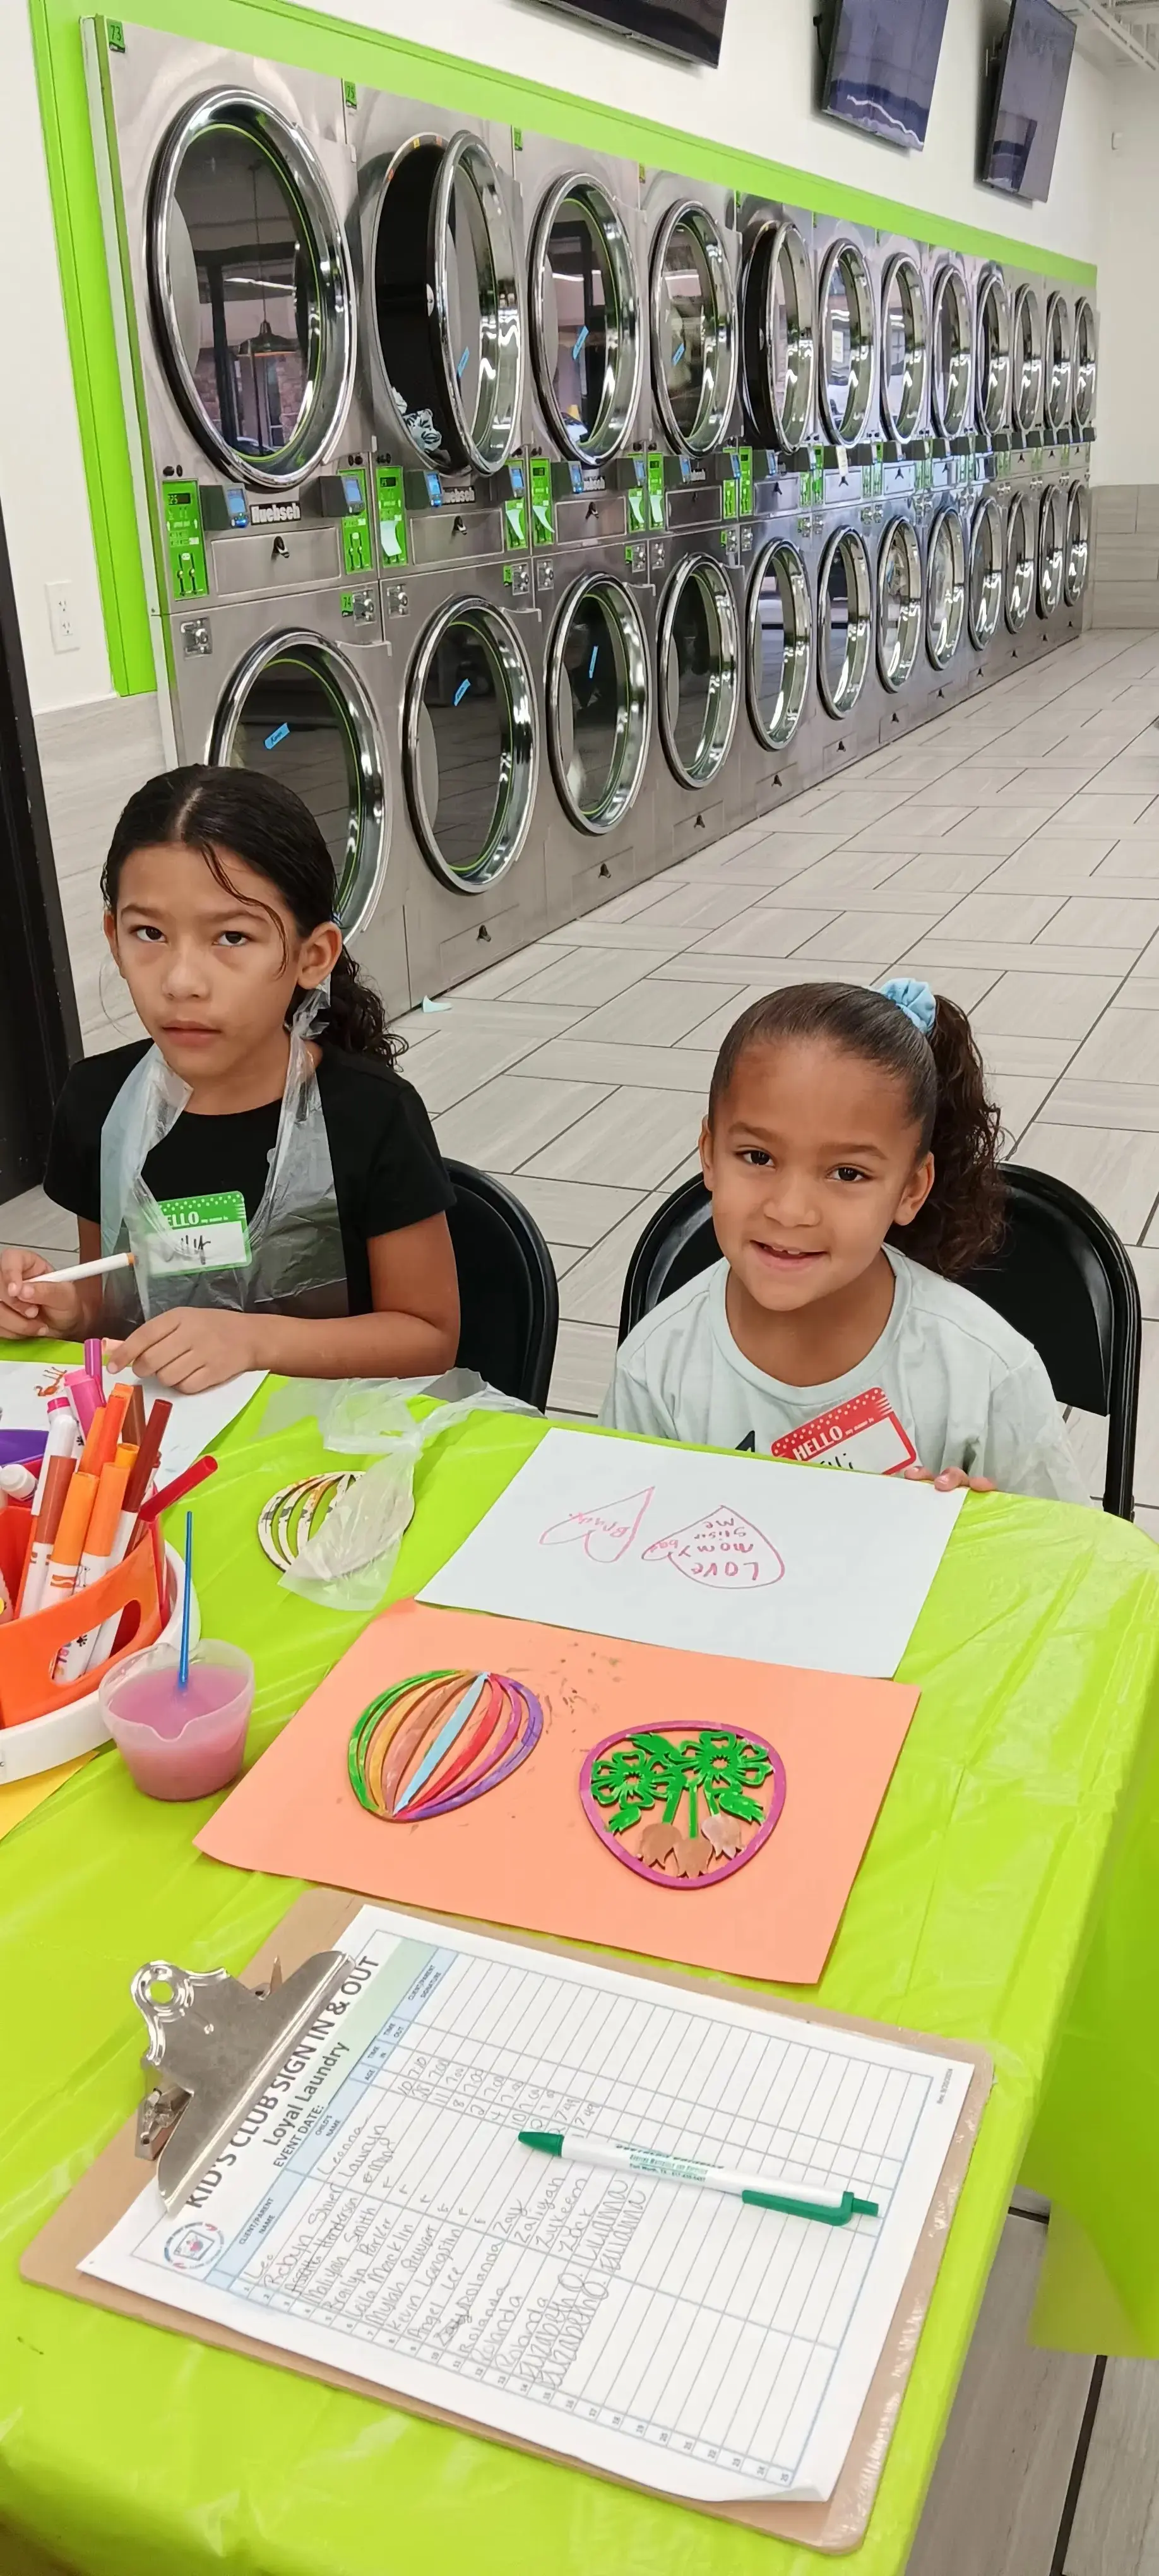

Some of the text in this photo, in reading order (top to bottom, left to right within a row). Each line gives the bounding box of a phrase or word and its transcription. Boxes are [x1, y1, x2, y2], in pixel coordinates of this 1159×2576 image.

[110, 25, 122, 41] 73
[347, 85, 355, 99] 75
[252, 503, 300, 525] Huebsch
[167, 1211, 199, 1227] ELLO
[792, 1425, 843, 1461] HELLO
[408, 1964, 435, 2000] CLIENT/PARENT
[420, 1972, 441, 1998] SIGNATURE
[383, 2022, 395, 2035] TIME
[393, 2026, 403, 2037] OUT
[367, 2046, 379, 2058] TIME
[186, 2152, 237, 2209] KID'S
[230, 2093, 280, 2148] CLUB
[271, 2042, 318, 2093] SIGN
[311, 2018, 336, 2042] IN
[326, 1998, 352, 2016] &
[341, 1955, 380, 1996] OUT
[364, 2069, 375, 2080] AGE
[262, 2042, 351, 2145] Loyal Laundry
[315, 2114, 332, 2135] CHILD'S
[325, 2119, 341, 2137] NAME
[273, 2104, 325, 2167] EVENT DATE:
[239, 2197, 273, 2244] CLIENT/PARENT
[258, 2214, 275, 2234] NAME
[343, 2208, 379, 2246] Smith
